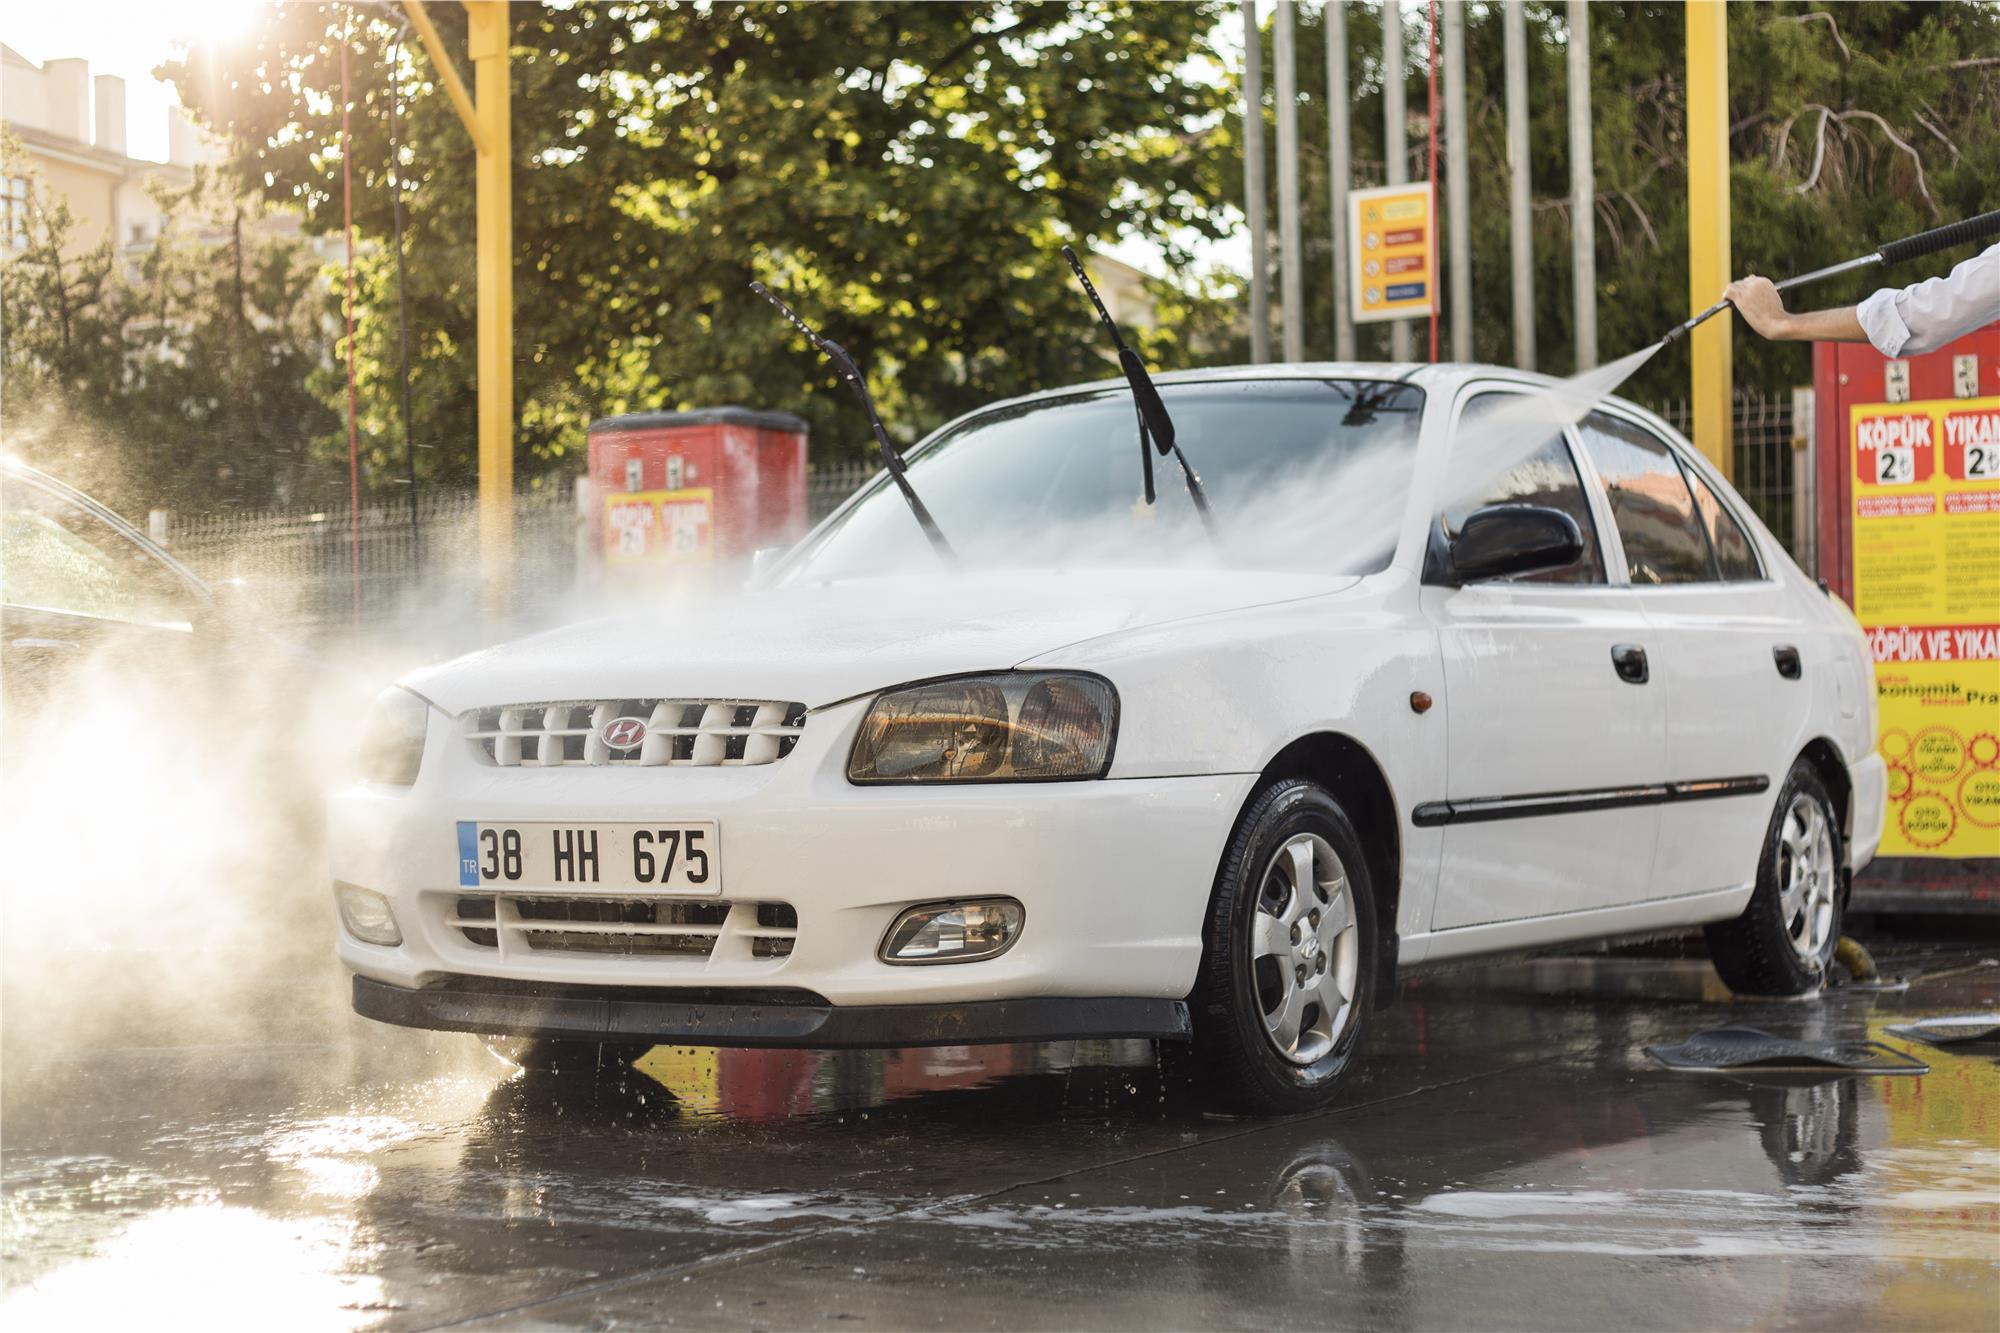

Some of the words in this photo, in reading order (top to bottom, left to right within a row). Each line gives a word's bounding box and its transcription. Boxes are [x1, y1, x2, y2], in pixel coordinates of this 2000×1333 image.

[1858, 414, 1932, 451] KÖPÜK
[1927, 629, 1952, 661] VE
[463, 859, 477, 874] TR
[480, 829, 522, 880] 38
[553, 830, 600, 882] HH
[633, 830, 708, 883] 675
